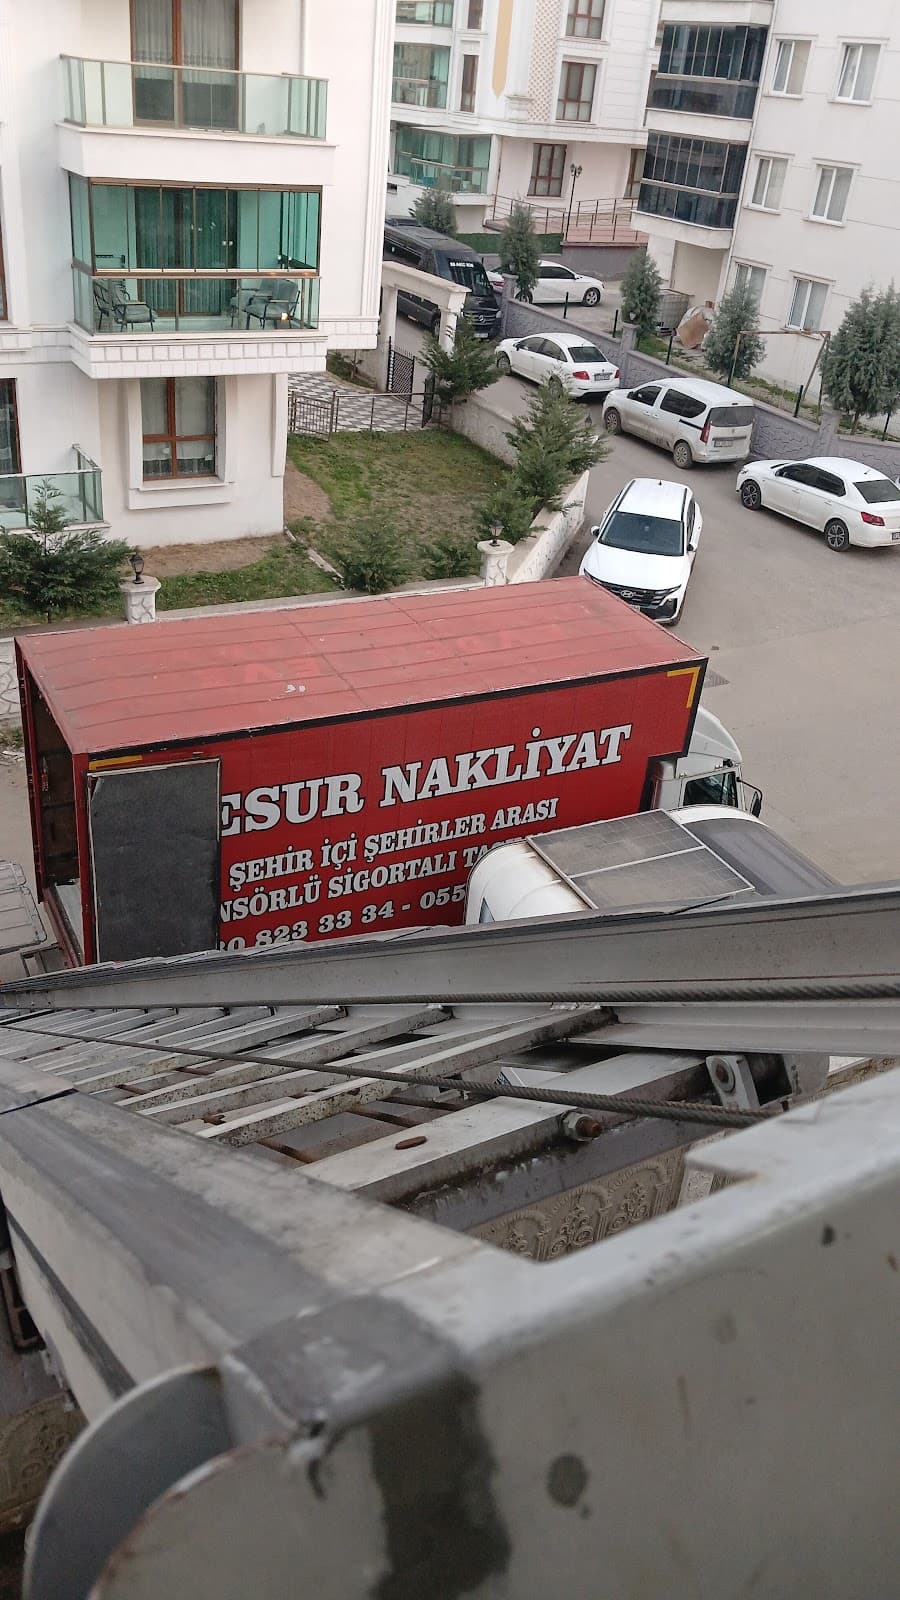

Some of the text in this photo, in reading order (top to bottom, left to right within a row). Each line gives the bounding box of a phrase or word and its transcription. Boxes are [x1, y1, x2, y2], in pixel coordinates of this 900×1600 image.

[379, 724, 632, 807] NAKLİYAT
[229, 845, 314, 891] ŞEHİR
[320, 832, 358, 870] İÇİ
[364, 813, 486, 863] ŞEHİRLER
[490, 798, 559, 830] ARASI
[327, 850, 457, 898] SİGORTALI
[255, 920, 308, 948] 823
[318, 910, 352, 933] 33
[361, 901, 394, 924] 34
